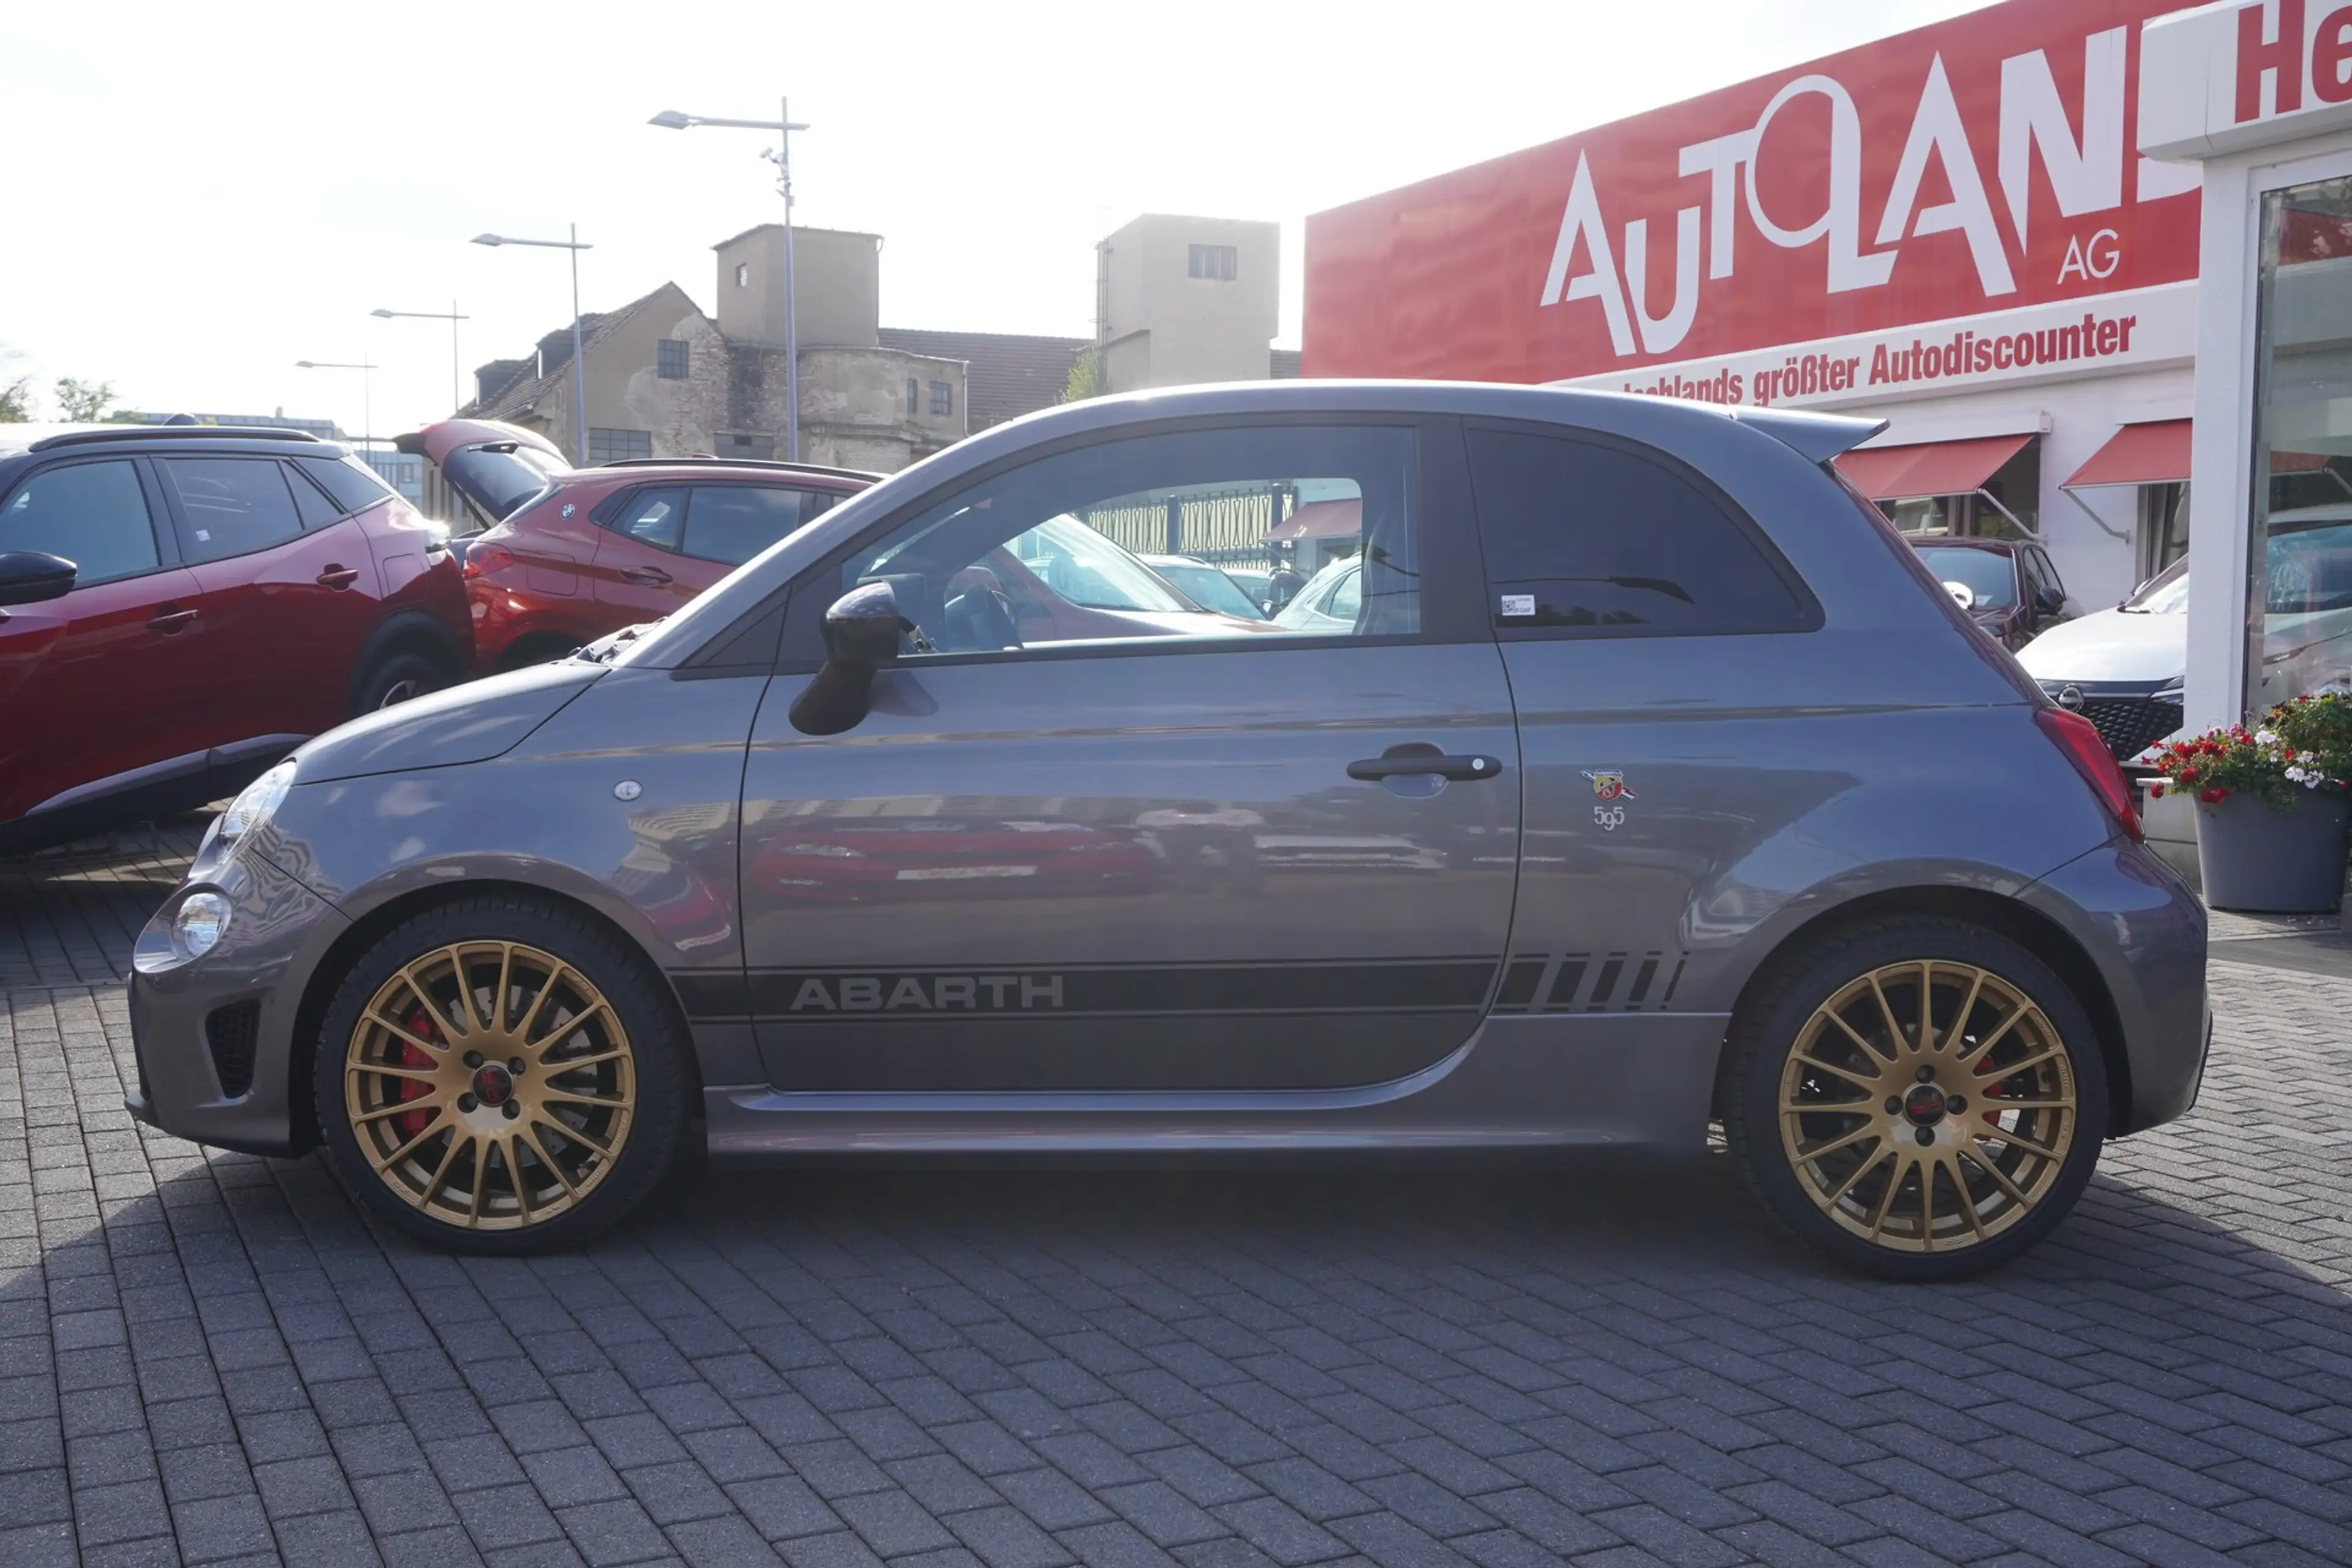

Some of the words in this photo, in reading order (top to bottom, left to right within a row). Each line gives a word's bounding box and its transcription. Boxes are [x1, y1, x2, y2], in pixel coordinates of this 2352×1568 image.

[2056, 228, 2120, 285] AG
[1754, 353, 1860, 407] größter
[1868, 313, 2136, 385] Autodiscounter
[1593, 806, 1625, 831] 595
[790, 975, 1063, 1010] ABARTH
